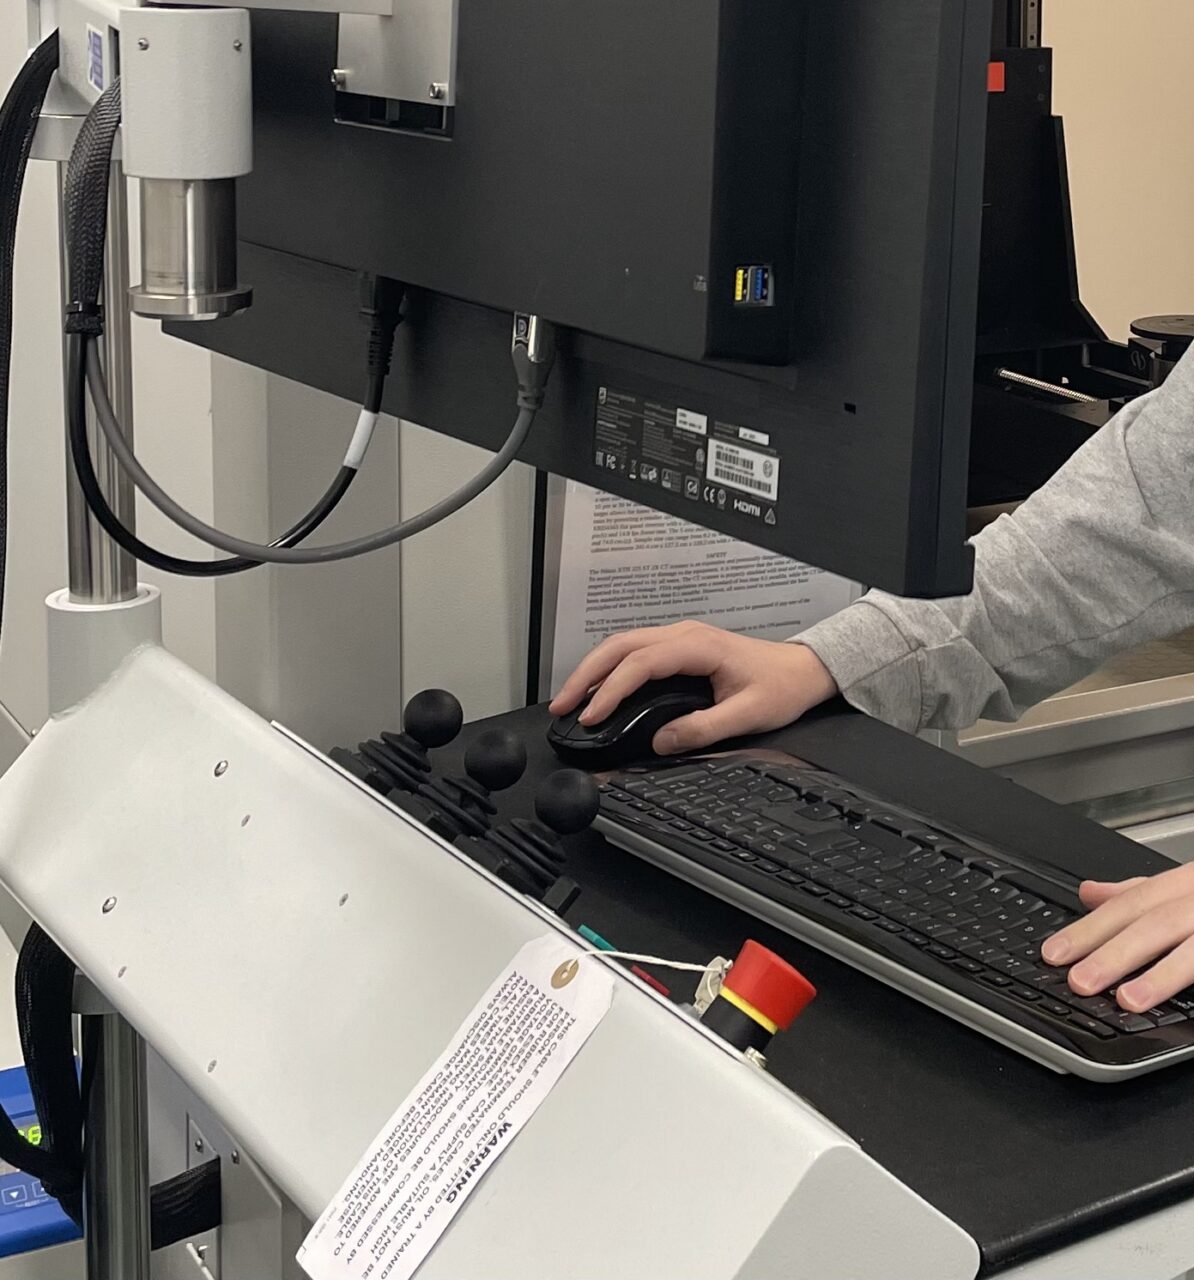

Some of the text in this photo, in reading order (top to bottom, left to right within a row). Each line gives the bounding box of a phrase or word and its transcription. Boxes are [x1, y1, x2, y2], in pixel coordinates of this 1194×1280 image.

[486, 969, 517, 1010] ALWAYS
[500, 992, 517, 1011] ALL
[518, 978, 528, 993] AT
[469, 1006, 503, 1047] CABLES
[479, 1014, 503, 1045] TIMES
[496, 996, 533, 1046] SUITABLE
[516, 997, 553, 1043] VOLTAGE
[545, 1005, 564, 1029] FOR
[556, 1017, 576, 1040] THIS
[443, 1010, 488, 1070] DISCHARGE
[508, 1032, 535, 1068] ESSEX
[514, 1029, 550, 1074] RUBBER
[448, 1045, 481, 1085] DURING
[453, 1047, 471, 1070] MAY
[531, 1041, 557, 1078] CABLE
[415, 1070, 443, 1104] CABLE
[420, 1070, 453, 1110] REMAIN
[486, 1068, 510, 1098] X-RAY
[496, 1077, 533, 1120] SHOULD
[333, 983, 535, 1256] ENSURE THAT SAFETY PROCEDURES ARE ADHERED TO
[392, 1086, 449, 1158] INSTALLATION
[463, 1074, 516, 1139] TERMINATED
[466, 1098, 486, 1122] CAN
[346, 992, 546, 1264] RUBBER TERMINATIONS SHOULD BE COMPRESSED BY
[383, 1104, 416, 1147] BEFORE
[437, 1121, 467, 1163] SUPPLY
[475, 1121, 497, 1149] ONLY
[382, 1158, 394, 1174] OF
[445, 1121, 512, 1203] WARNING
[462, 1149, 475, 1165] BE
[353, 1164, 379, 1199] AFTER
[361, 1176, 381, 1200] THIS
[389, 1172, 430, 1224] SUITABLE
[414, 1185, 430, 1203] OIL
[434, 1166, 463, 1204] FITTED
[337, 1200, 355, 1223] USE
[391, 1205, 415, 1238] MUST
[423, 1204, 435, 1221] BY
[369, 1224, 391, 1254] HIGH
[374, 1237, 391, 1262] NOT
[380, 1232, 416, 1280] TRAINED
[361, 1262, 374, 1280] BE
